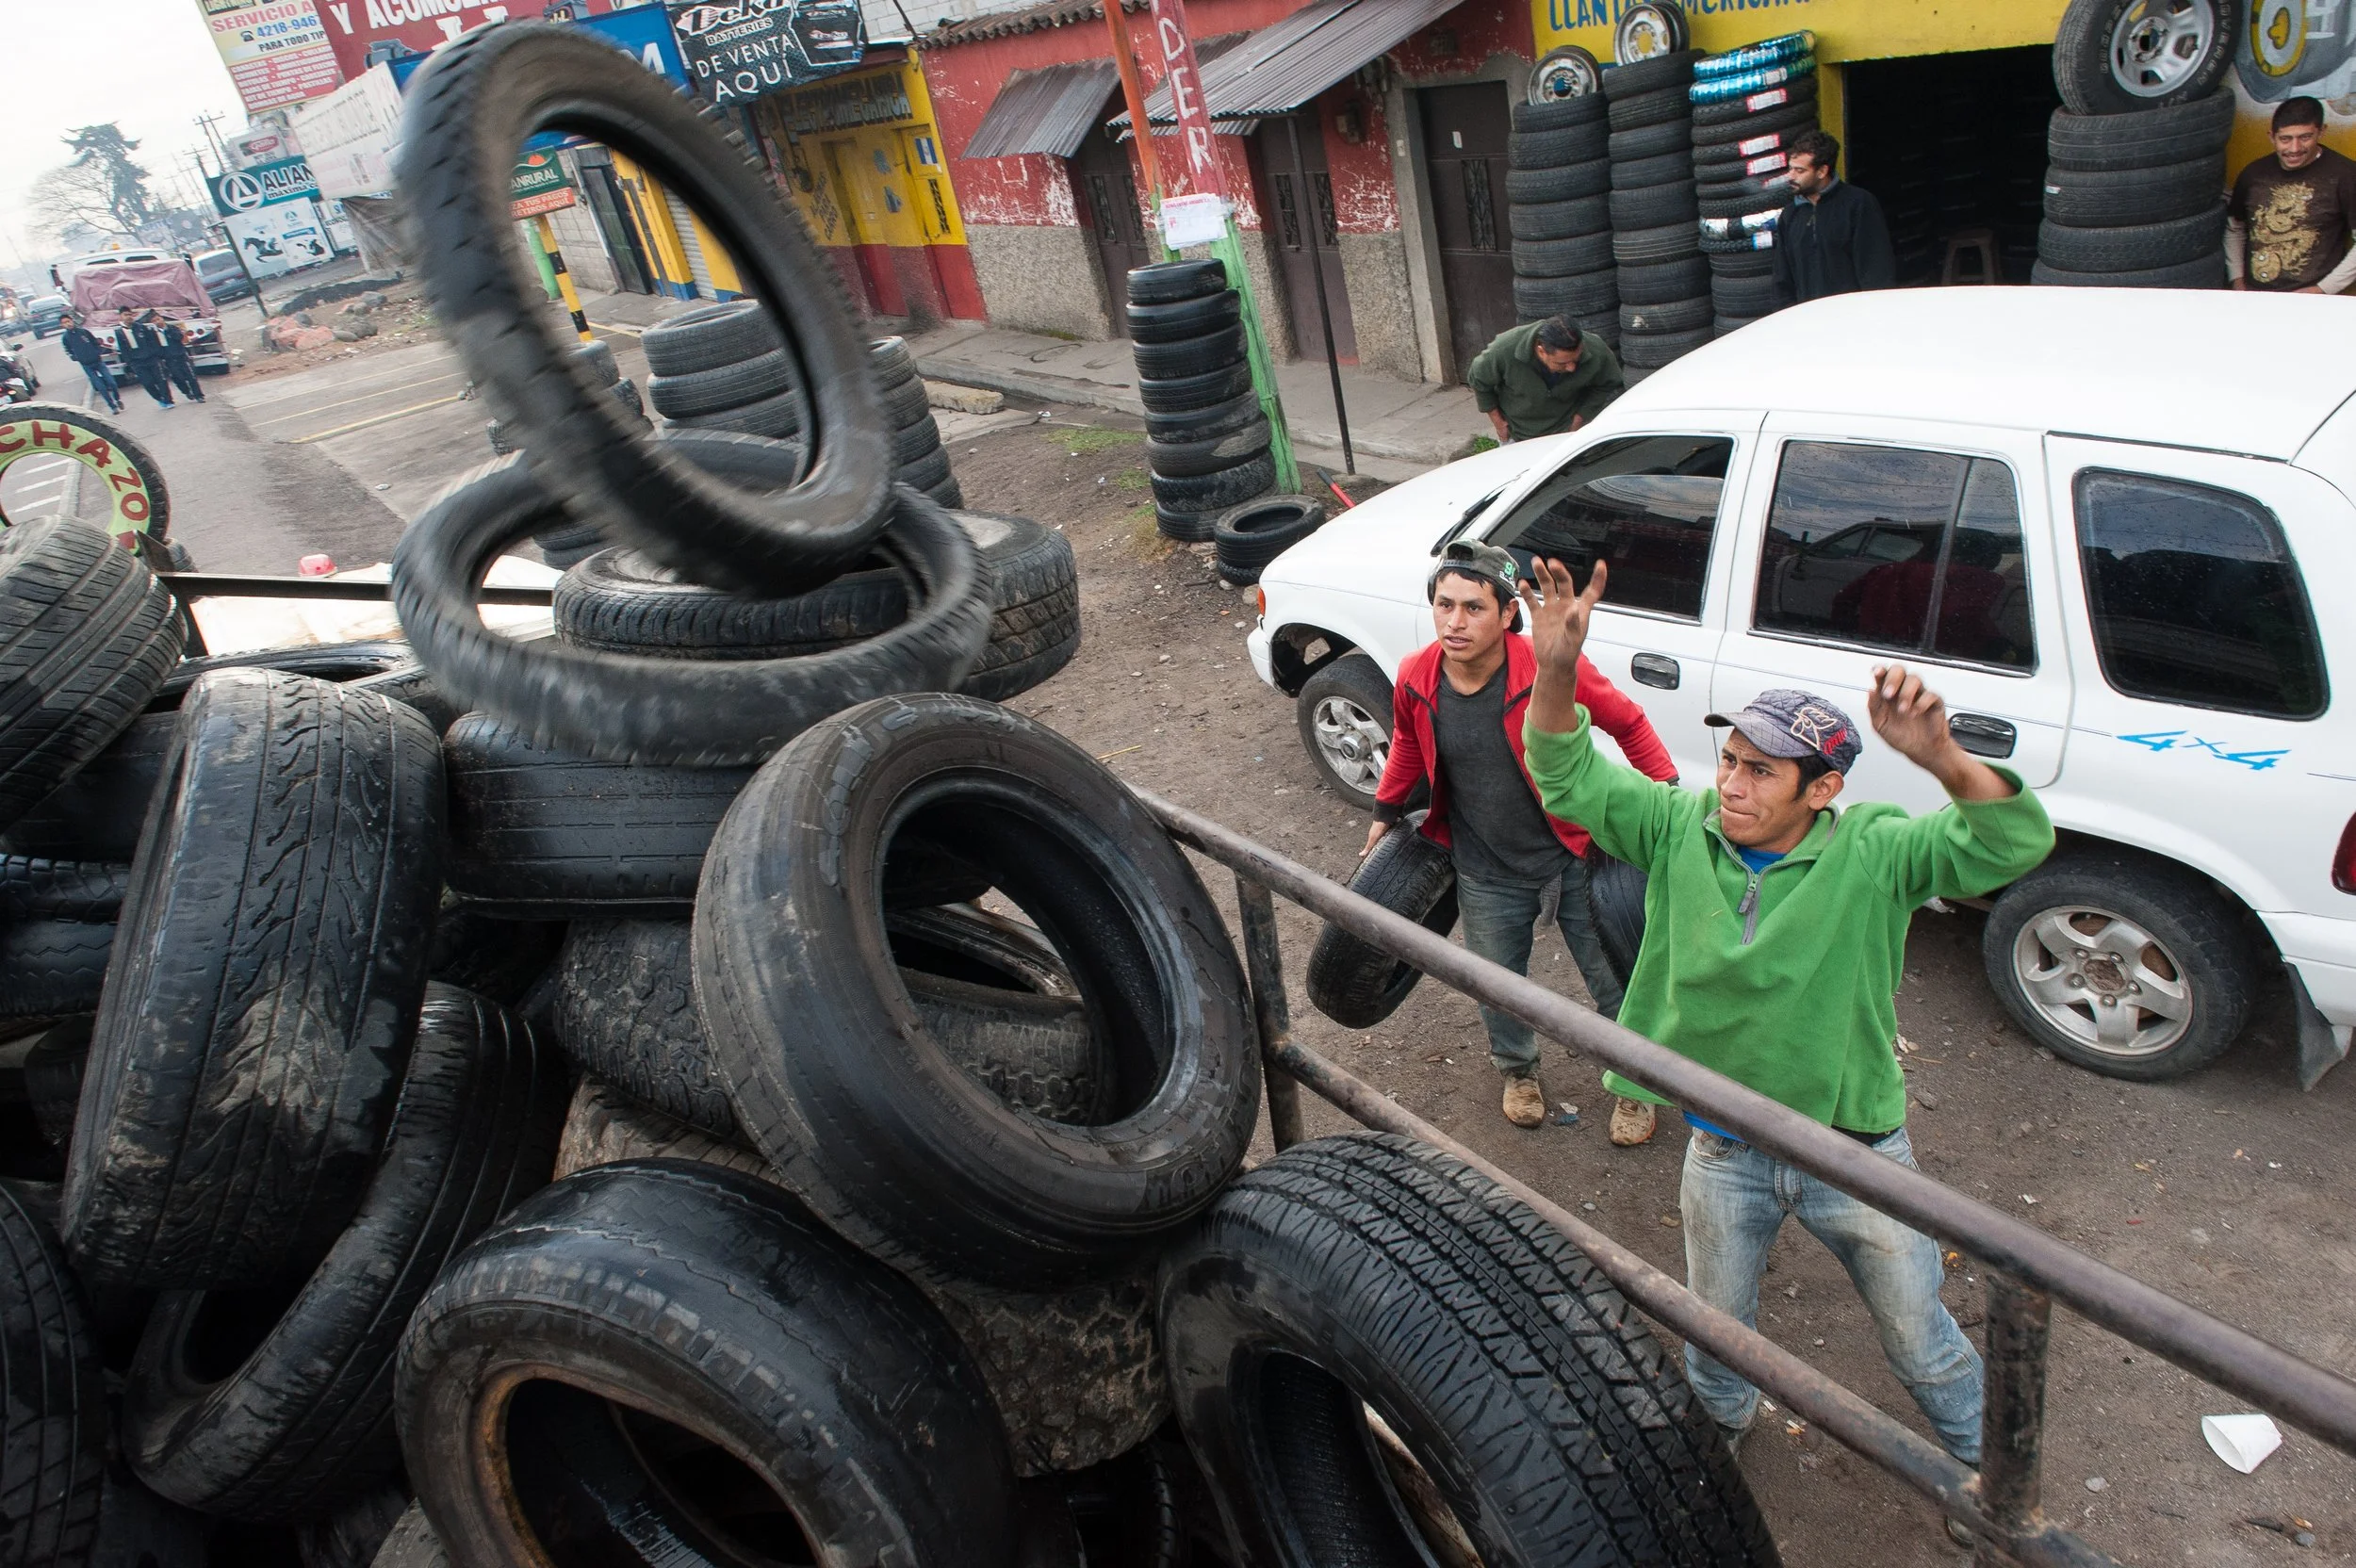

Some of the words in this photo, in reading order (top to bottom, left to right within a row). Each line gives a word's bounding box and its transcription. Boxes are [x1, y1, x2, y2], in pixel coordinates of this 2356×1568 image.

[211, 4, 297, 33] SERVICIO
[329, 3, 354, 35] Y
[707, 17, 773, 46] BATTERIES
[258, 40, 284, 53] PARA
[284, 34, 309, 46] TODO
[696, 55, 725, 78] DE
[727, 33, 795, 66] VENTA
[715, 53, 793, 103] AQUÍ
[1152, 0, 1214, 178] DER
[510, 168, 560, 189] ANRURAL
[525, 197, 541, 207] TUS
[541, 190, 569, 204] PAGOS
[0, 420, 150, 549] CHAZO
